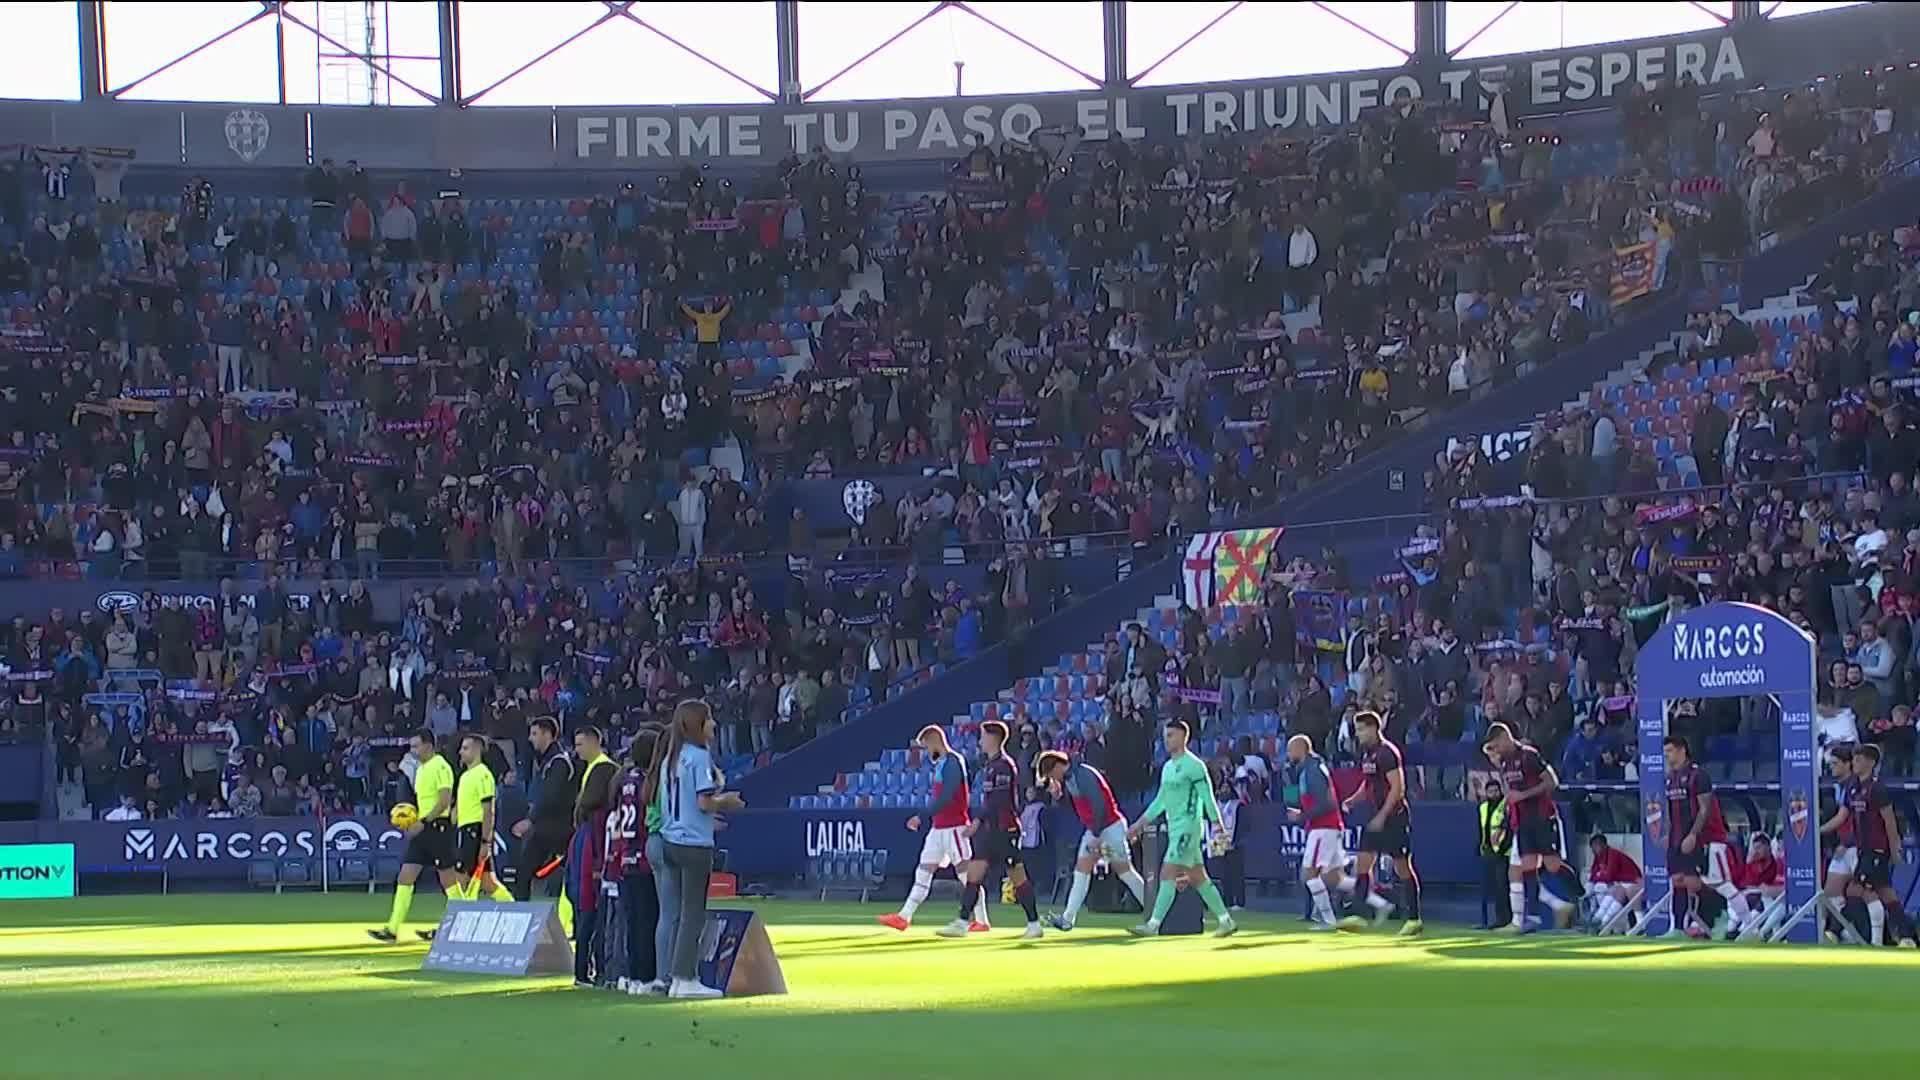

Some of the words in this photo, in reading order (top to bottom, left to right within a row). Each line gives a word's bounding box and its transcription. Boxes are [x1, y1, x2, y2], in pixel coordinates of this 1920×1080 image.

[577, 115, 761, 158] FIRME
[784, 112, 860, 154] TU
[884, 103, 1042, 150] PASO
[1077, 97, 1145, 141] EL
[1166, 75, 1422, 136] TRIUNFO
[1531, 36, 1745, 104] ESPERA
[1674, 623, 1764, 660] MARCOS
[1700, 664, 1764, 687] automoción
[621, 803, 636, 838] 22
[806, 820, 865, 856] LALIGA
[125, 829, 313, 860] MARCOS
